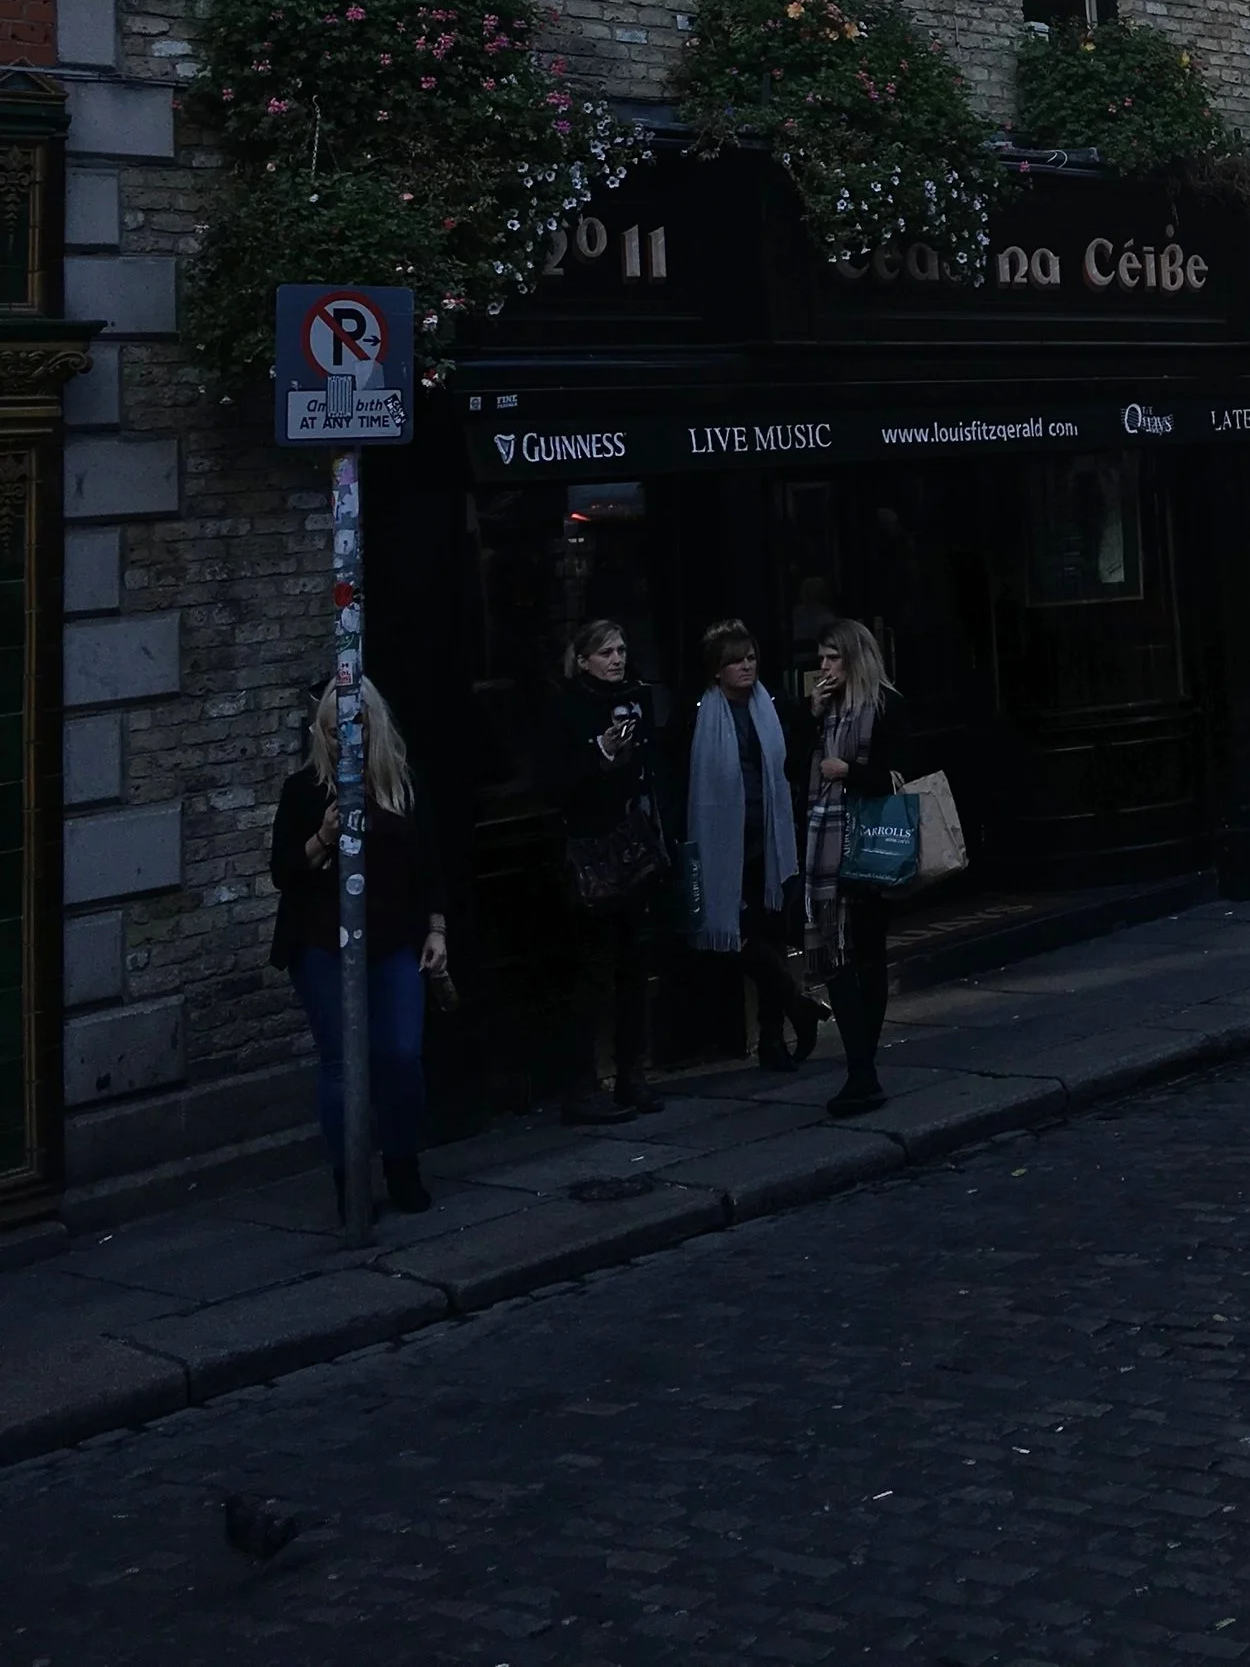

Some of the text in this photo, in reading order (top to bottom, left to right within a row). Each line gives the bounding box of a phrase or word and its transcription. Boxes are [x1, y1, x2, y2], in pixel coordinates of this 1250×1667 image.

[996, 244, 1061, 287] na
[356, 399, 383, 411] bith
[300, 416, 390, 429] AT ANY TIME
[881, 417, 1079, 444] www.louisfitzgeraldcom
[522, 432, 626, 463] GUINNESS
[687, 423, 833, 455] LIVE MUSIC
